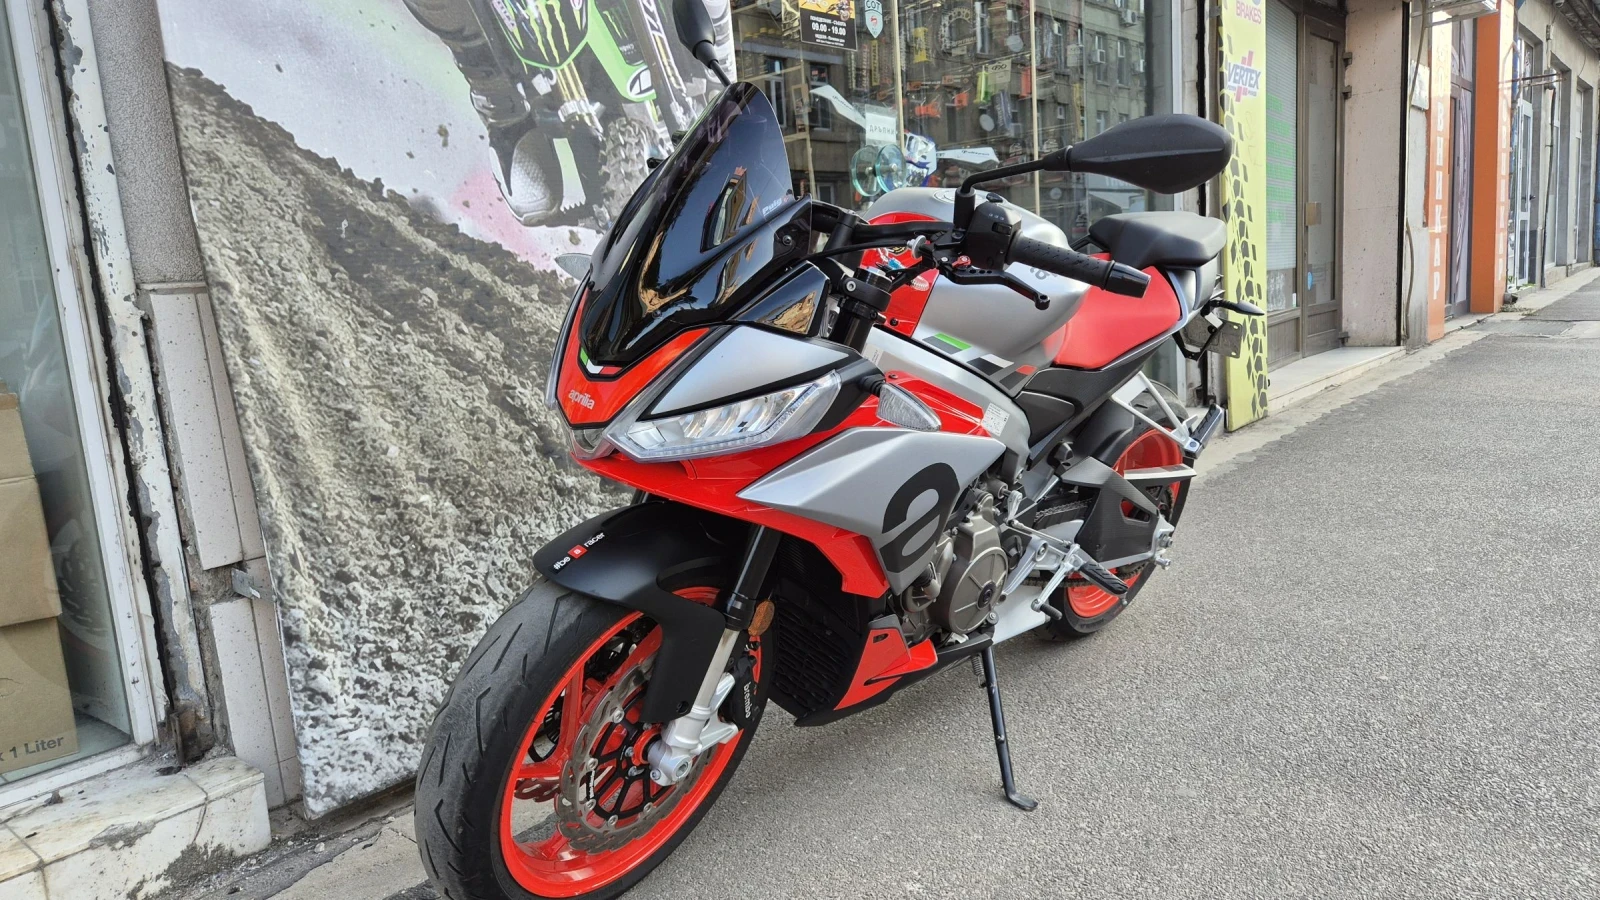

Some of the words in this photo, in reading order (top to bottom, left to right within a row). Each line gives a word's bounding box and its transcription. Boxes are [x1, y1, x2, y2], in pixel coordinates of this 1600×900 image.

[1236, 1, 1261, 24] BRAKES
[811, 22, 827, 32] 09.00
[831, 26, 847, 36] 19.00
[1228, 63, 1261, 90] VERTEX
[568, 389, 595, 410] aprilia
[553, 556, 571, 570] #be
[583, 532, 605, 548] racer
[743, 681, 753, 719] brembo
[9, 745, 17, 758] 1
[24, 736, 64, 755] Liter
